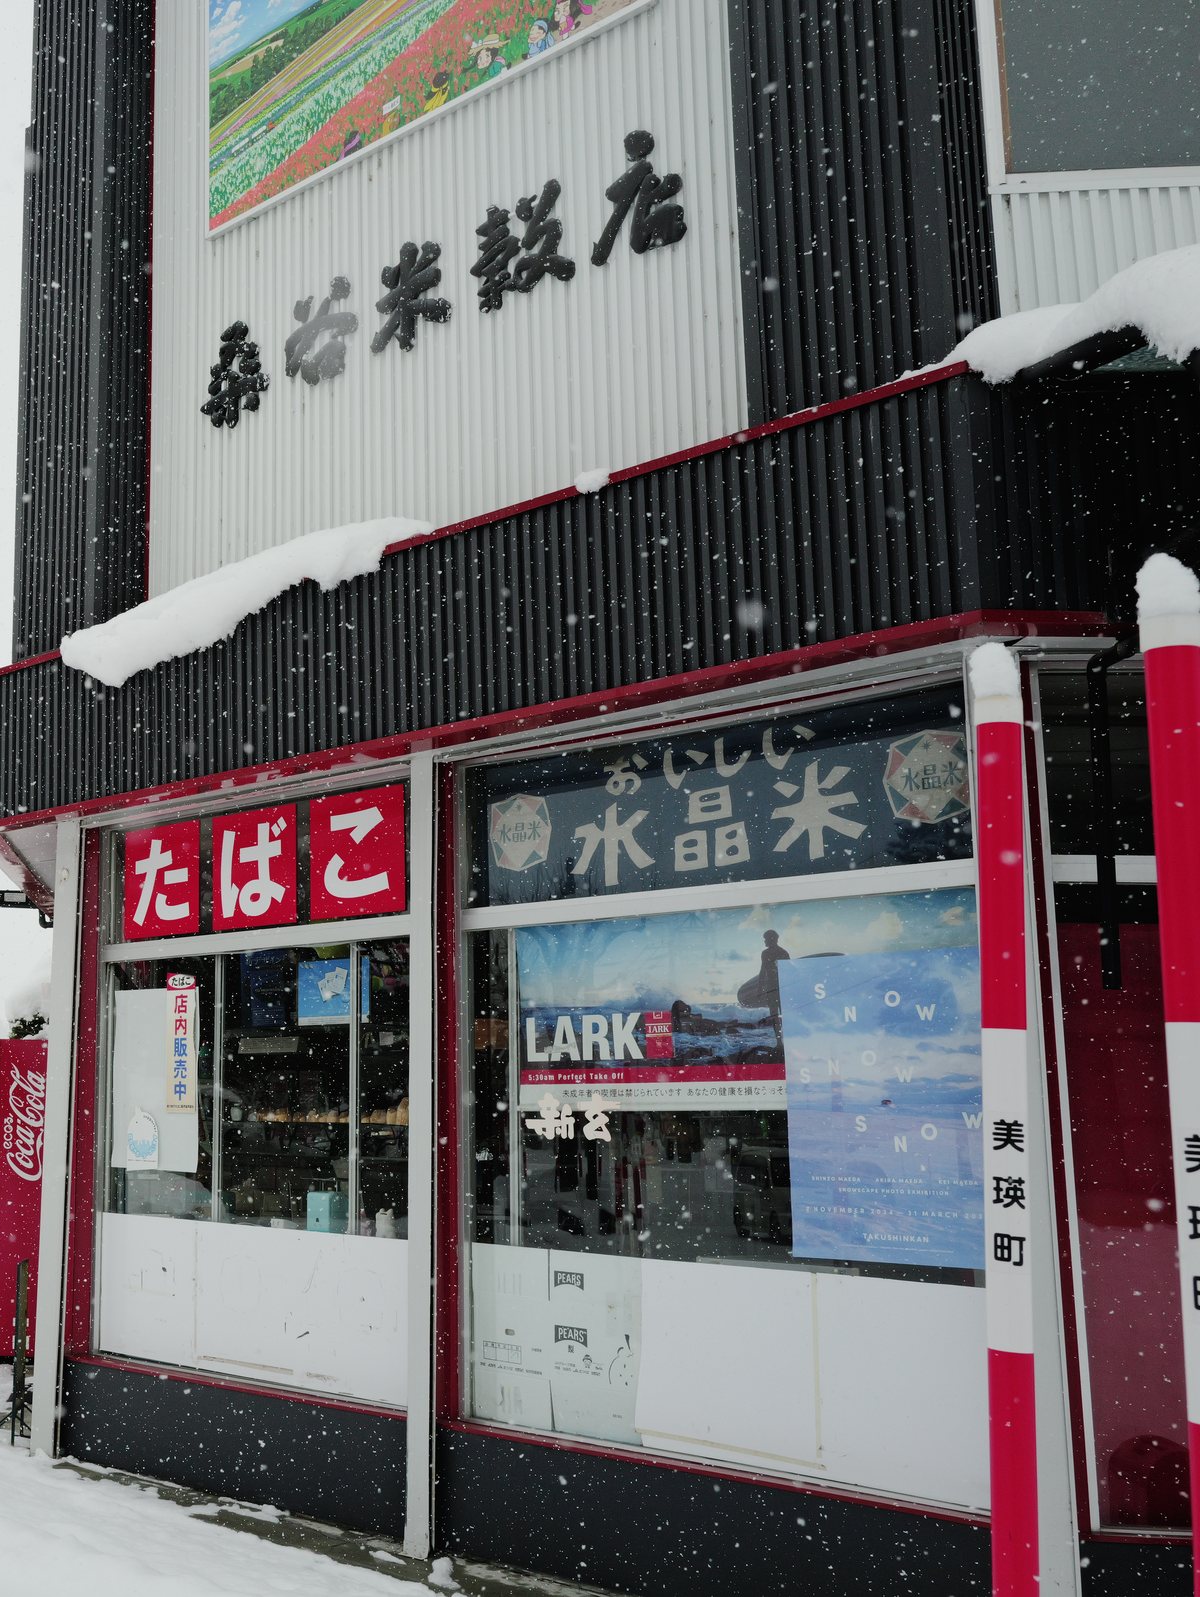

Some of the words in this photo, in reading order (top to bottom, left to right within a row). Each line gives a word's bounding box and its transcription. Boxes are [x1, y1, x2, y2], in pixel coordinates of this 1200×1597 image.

[603, 724, 816, 795] おいしい
[571, 759, 868, 886] 水晶米
[132, 805, 390, 926] たばこ
[174, 993, 188, 1101] 店内販売中
[525, 1012, 644, 1062] LARK
[648, 1025, 670, 1034] LARK
[528, 1073, 555, 1081] 5:30am
[557, 1073, 586, 1081] Perfect
[589, 1072, 608, 1080] Take
[611, 1072, 624, 1080] Off
[6, 1062, 46, 1182] Coca-Cola
[992, 1119, 1026, 1266] 美瑛町
[862, 1232, 929, 1243] TAKUSHINKAN
[557, 1272, 582, 1287] PEARS
[558, 1327, 585, 1343] PEARS
